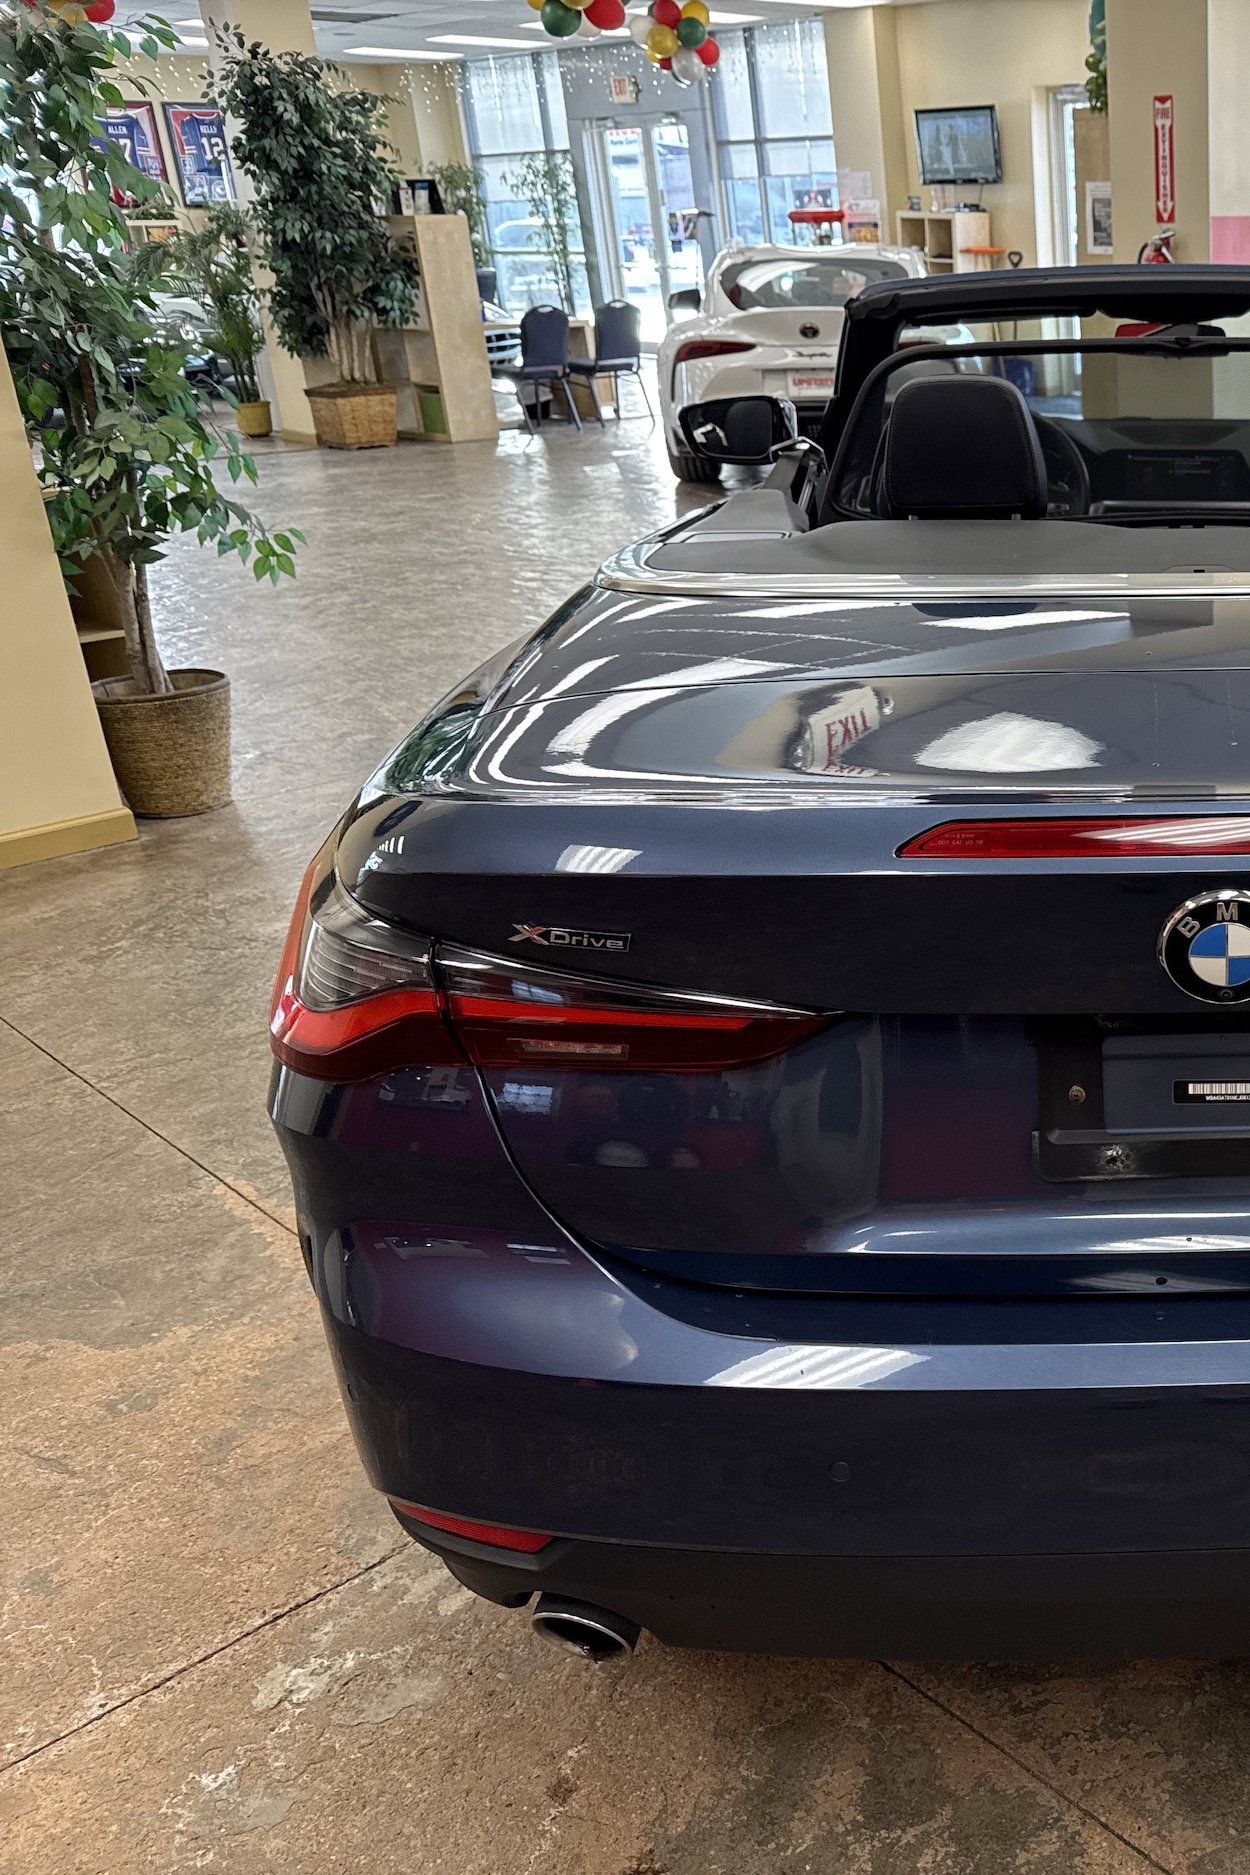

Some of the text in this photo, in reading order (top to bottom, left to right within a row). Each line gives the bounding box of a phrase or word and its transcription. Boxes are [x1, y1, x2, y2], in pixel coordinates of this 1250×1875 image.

[1155, 107, 1170, 119] FIRE
[108, 125, 128, 134] ALLEN
[201, 137, 225, 160] 12
[1160, 123, 1168, 213] EXTINGUISHER
